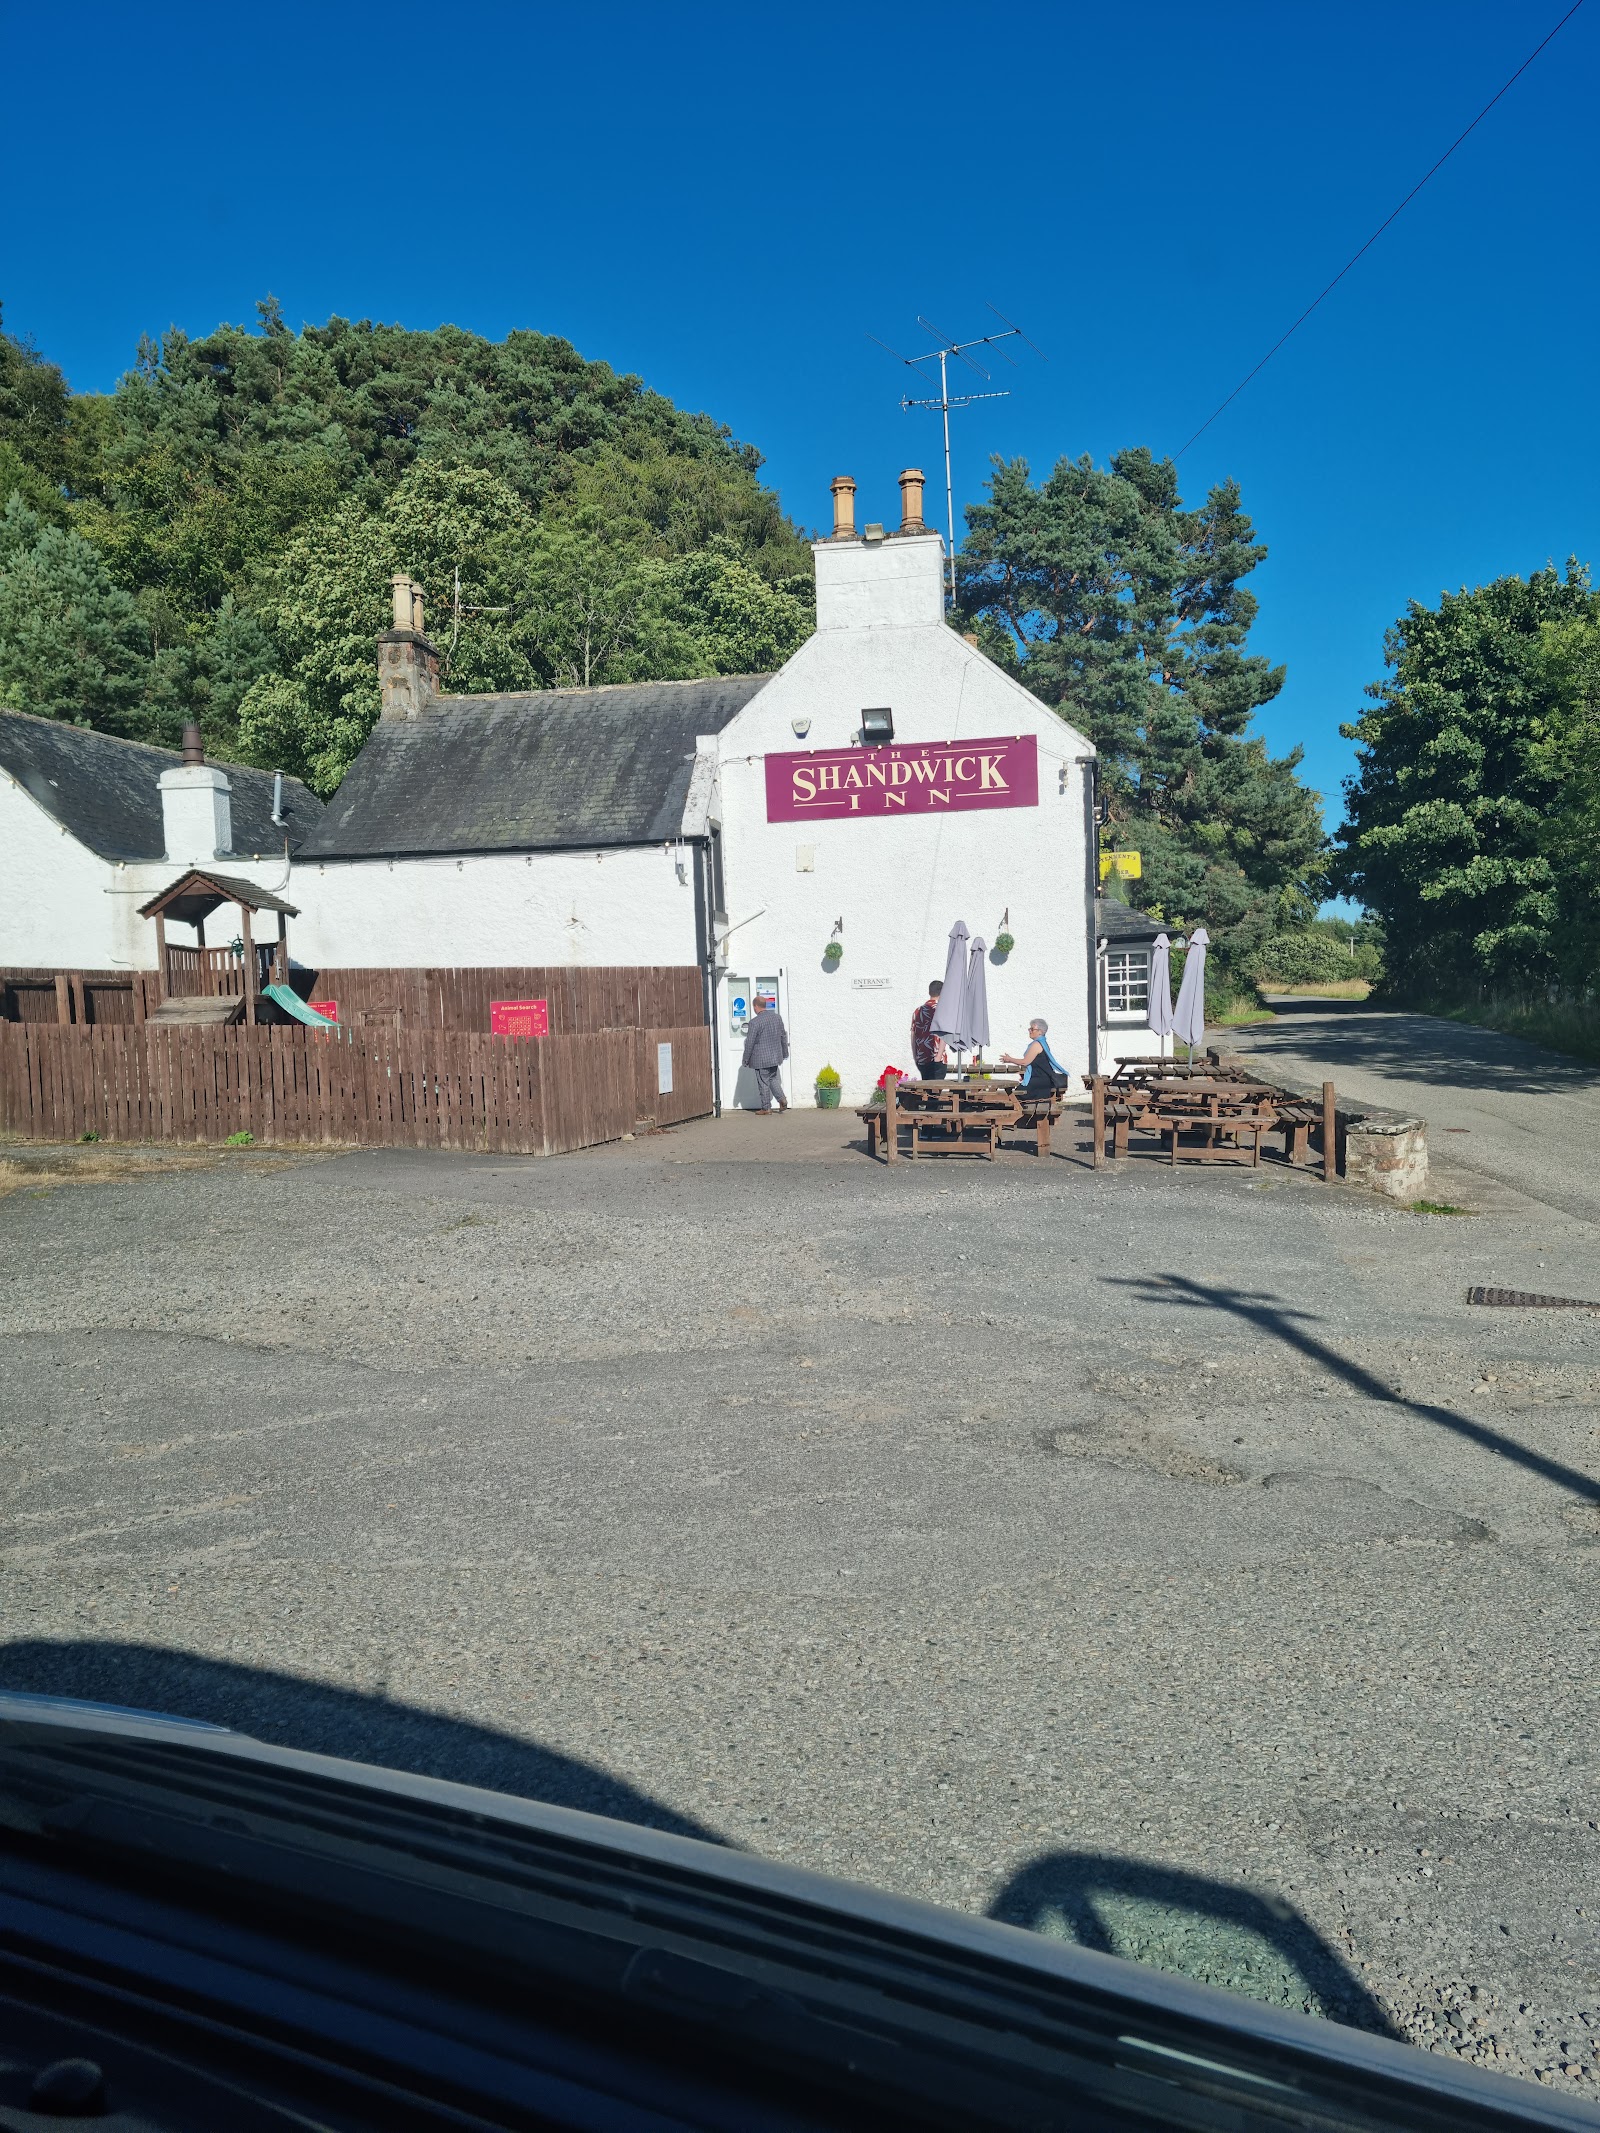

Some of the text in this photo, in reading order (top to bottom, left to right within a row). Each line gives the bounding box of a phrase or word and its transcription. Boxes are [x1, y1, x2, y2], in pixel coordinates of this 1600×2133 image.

[867, 749, 930, 760] THE
[792, 755, 1010, 802] SHANDWICK
[848, 788, 952, 810] INN
